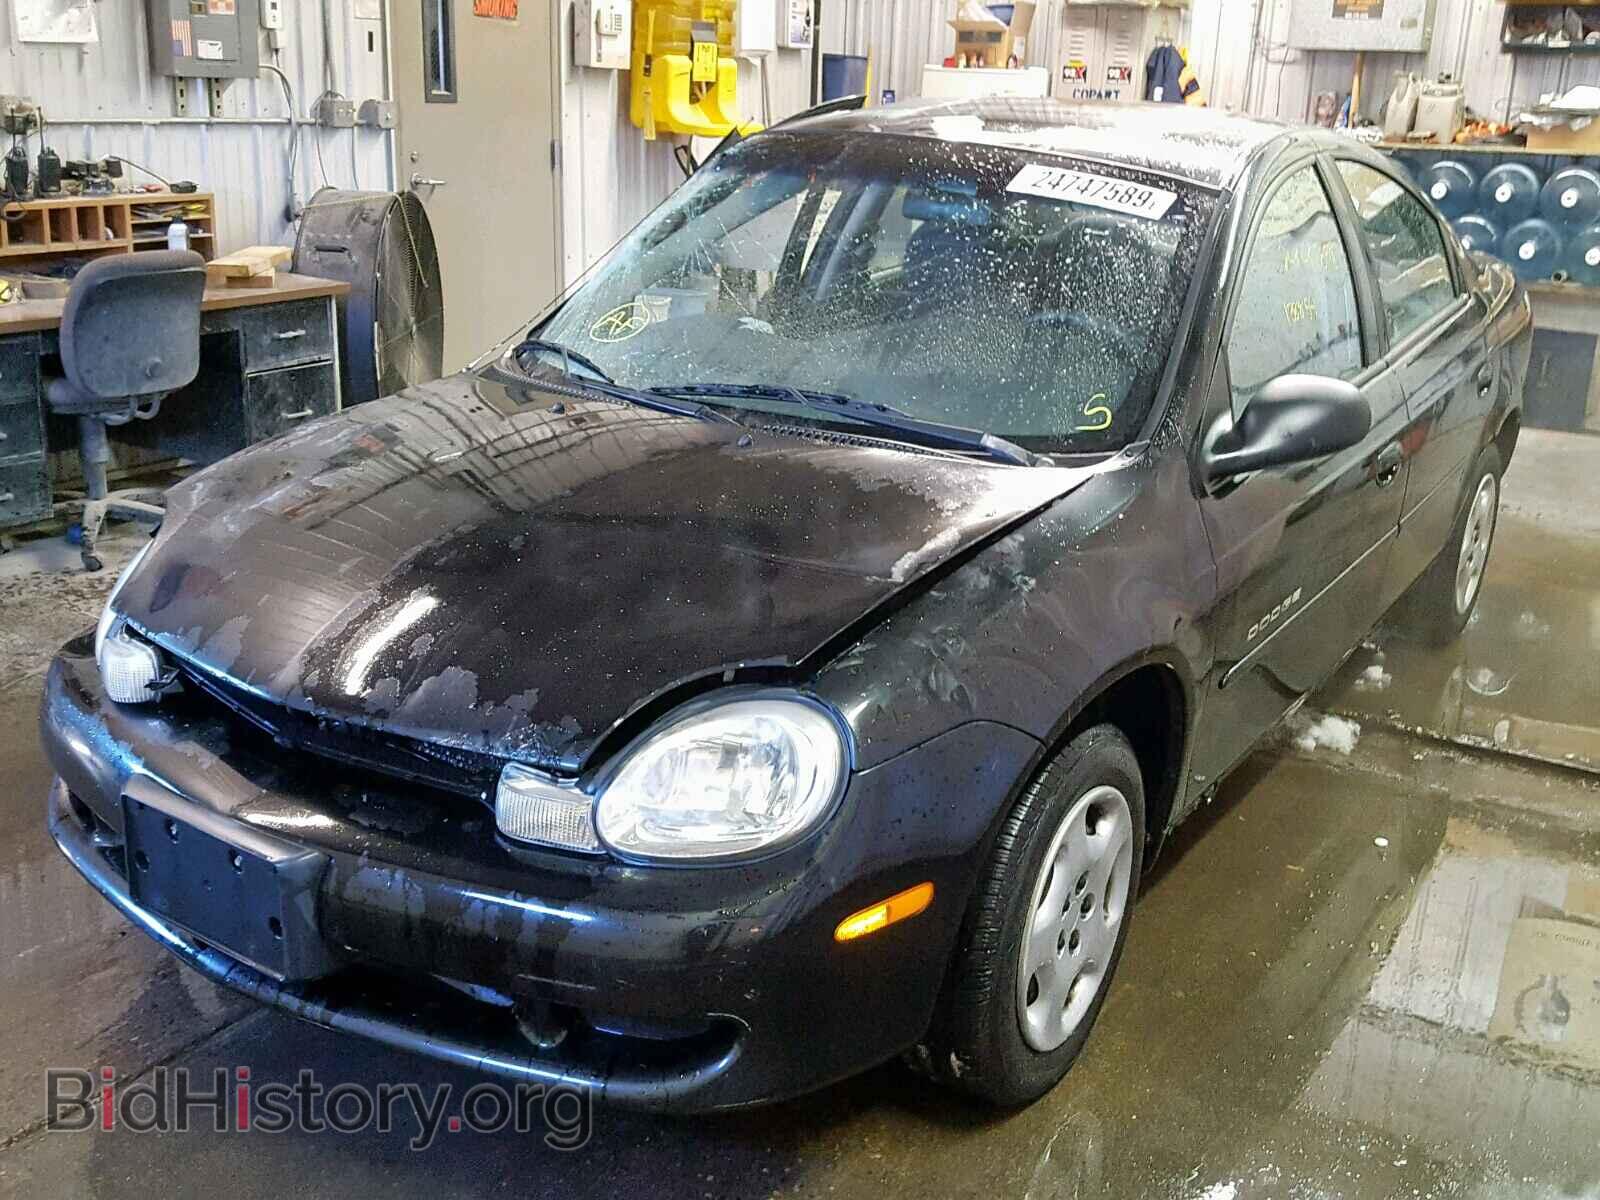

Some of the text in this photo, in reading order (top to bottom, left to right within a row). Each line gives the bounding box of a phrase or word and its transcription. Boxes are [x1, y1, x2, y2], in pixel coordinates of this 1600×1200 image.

[473, 0, 517, 17] SMOKING
[1073, 87, 1120, 100] COPART
[1031, 171, 1154, 208] 24747589
[1247, 587, 1302, 641] DODGE
